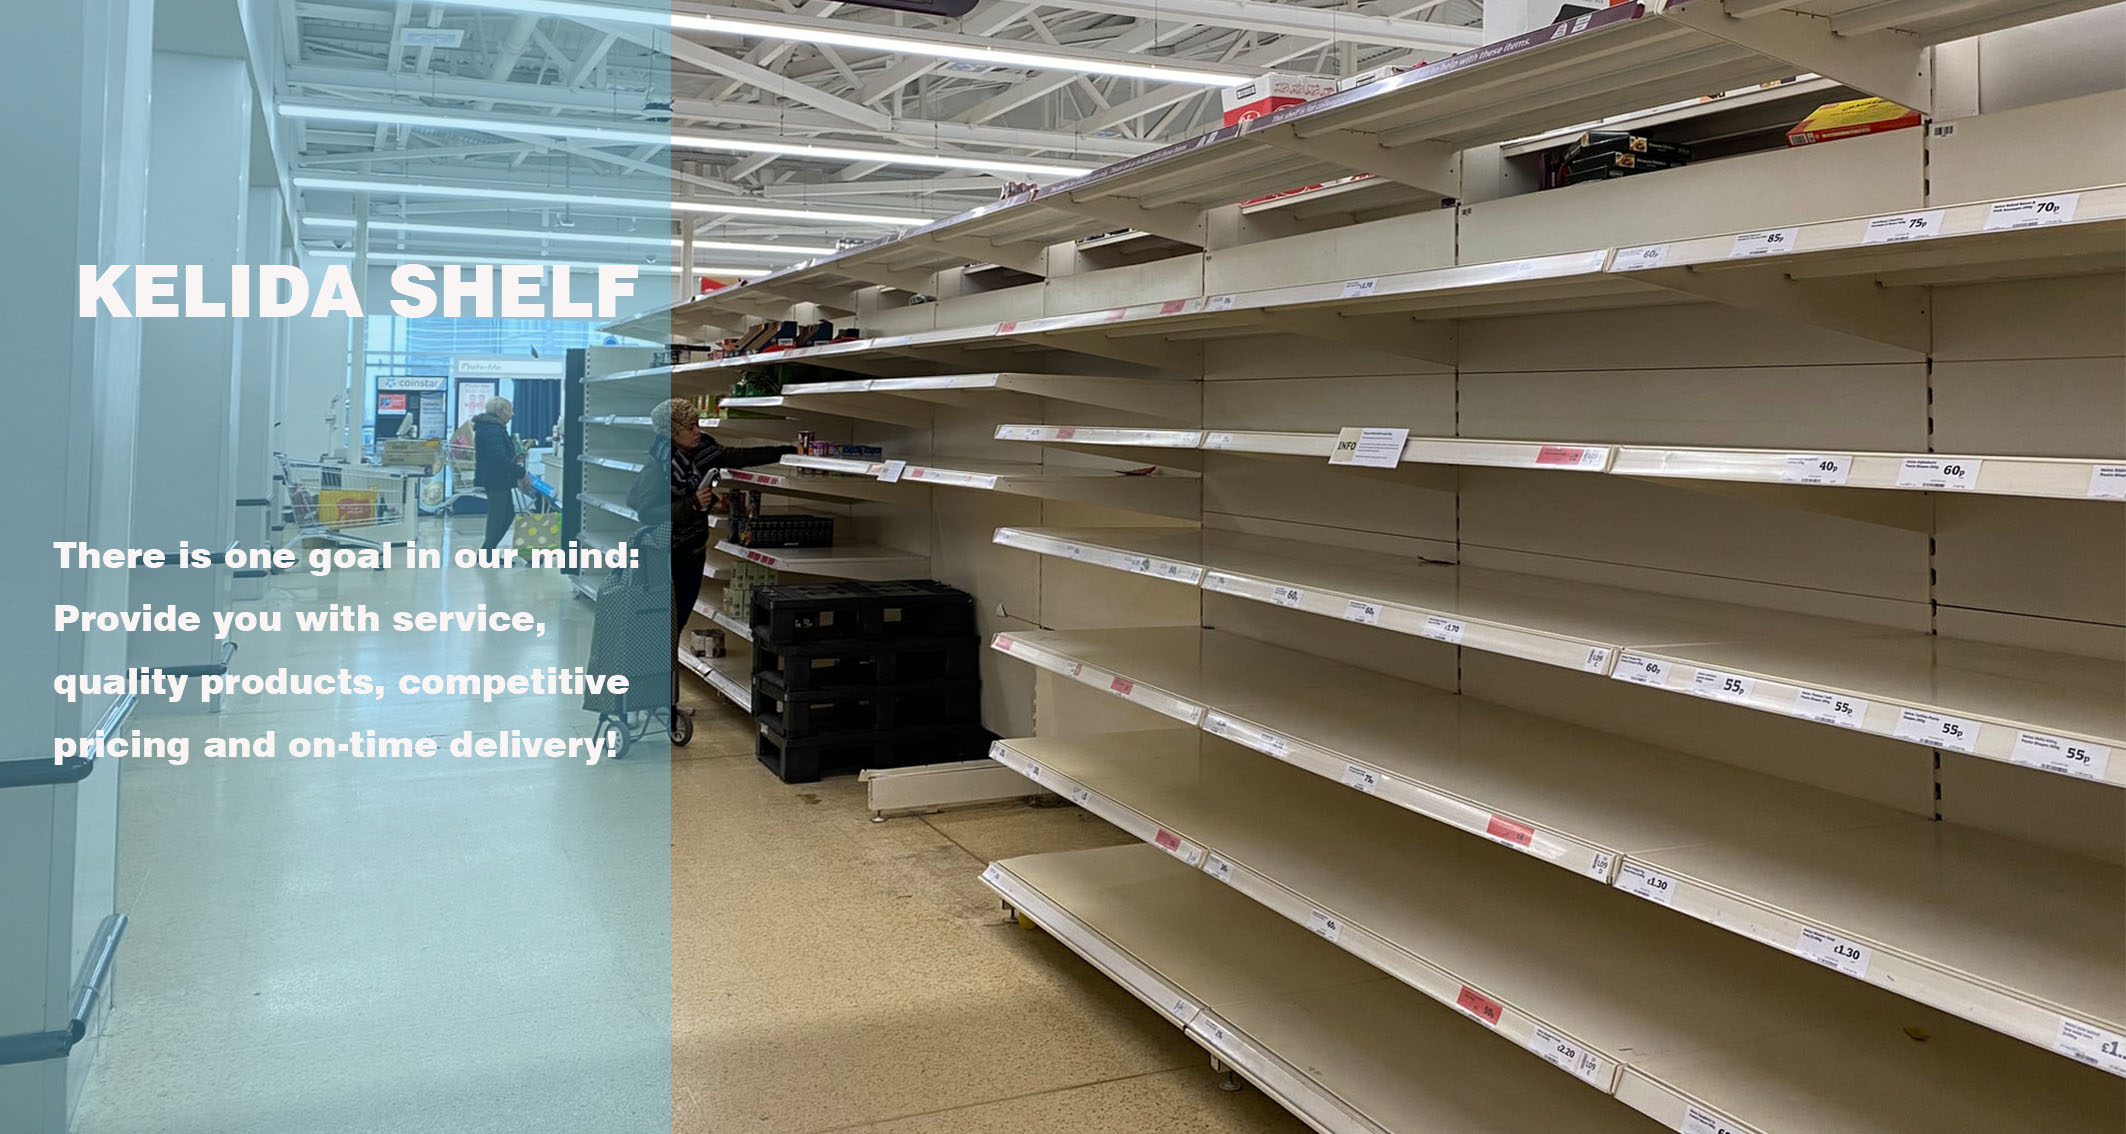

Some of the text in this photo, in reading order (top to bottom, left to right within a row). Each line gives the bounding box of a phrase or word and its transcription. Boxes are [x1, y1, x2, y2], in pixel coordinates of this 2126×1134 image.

[2036, 201, 2060, 213] 70p
[1908, 218, 1928, 228] 75p
[1767, 233, 1784, 243] 85p
[1643, 249, 1659, 258] 60p
[398, 378, 439, 388] coinstar
[1337, 441, 1357, 451] INFO
[1819, 461, 1838, 473] 40p
[1943, 464, 1966, 477] 60p
[1645, 662, 1661, 675] 60p
[1723, 678, 1745, 695] 55p
[1834, 701, 1853, 715] 55p
[1941, 722, 1963, 738] 55p
[2066, 747, 2091, 764] 55p
[1647, 877, 1668, 890] £1.30
[1833, 944, 1861, 960] £1.30
[1557, 1044, 1576, 1058] £2.20
